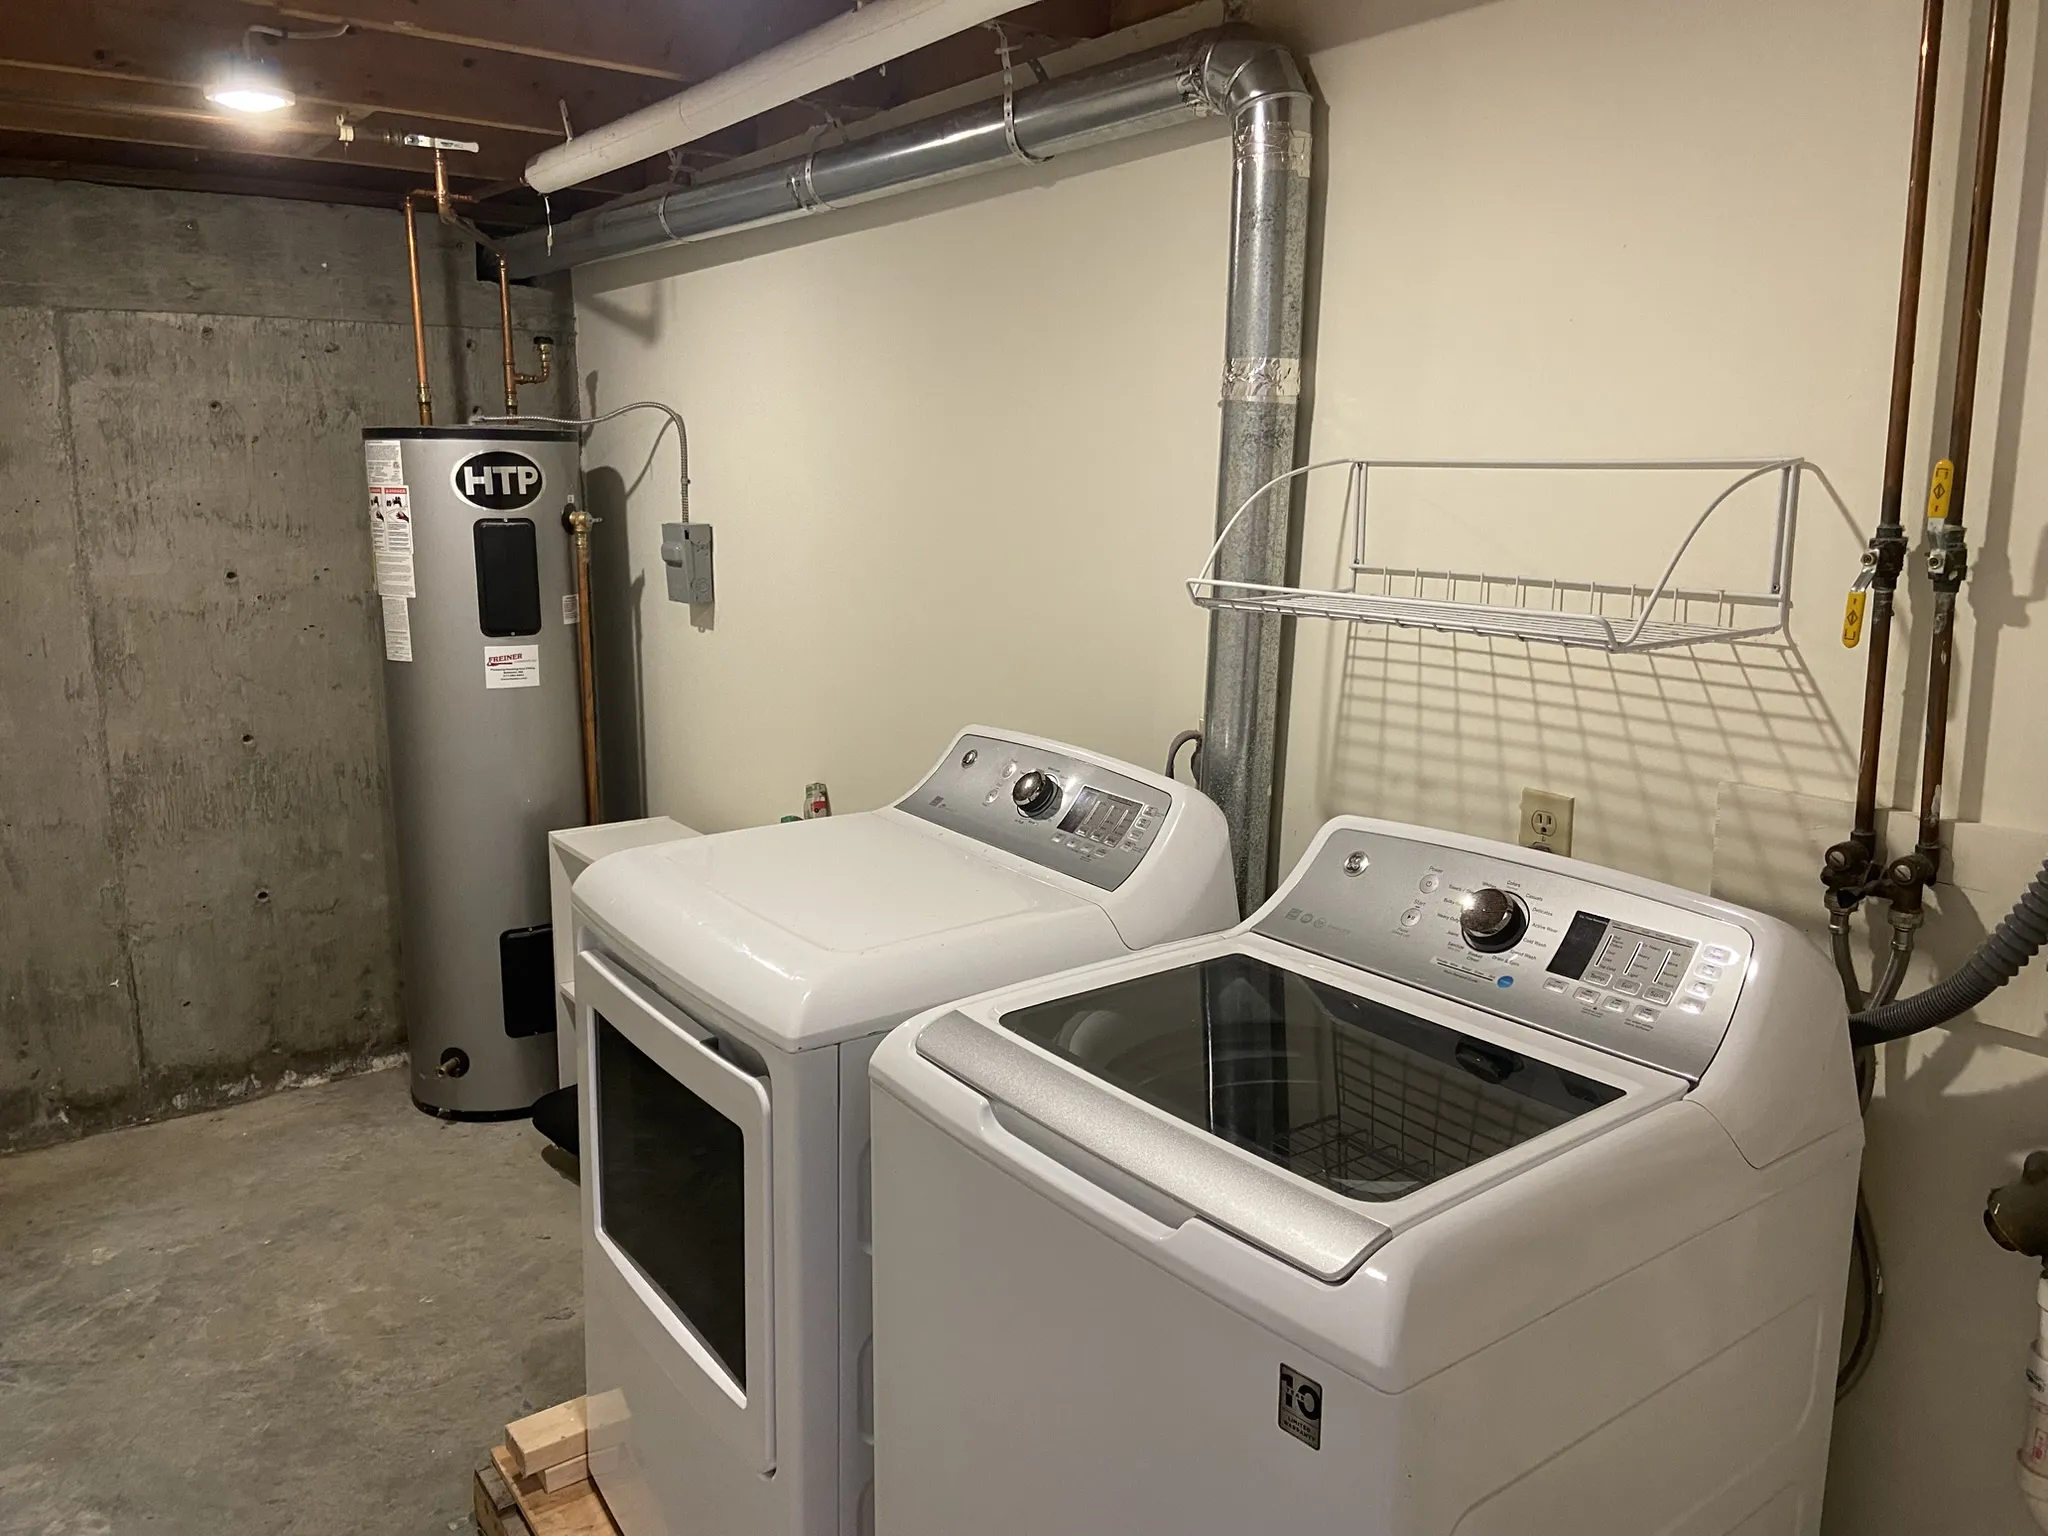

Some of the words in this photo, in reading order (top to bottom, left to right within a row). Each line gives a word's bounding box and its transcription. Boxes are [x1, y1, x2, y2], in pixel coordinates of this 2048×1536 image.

[463, 465, 539, 496] HTP
[1429, 865, 1443, 873] Power
[1507, 880, 1521, 888] Colors
[1525, 893, 1543, 901] Casuals
[1532, 907, 1553, 916] Delicates
[1523, 937, 1534, 945] Cold
[1534, 940, 1547, 948] Wash
[1650, 990, 1664, 999] Spin
[1287, 1415, 1311, 1433] LIMITED
[1283, 1420, 1315, 1441] WARRANTY
